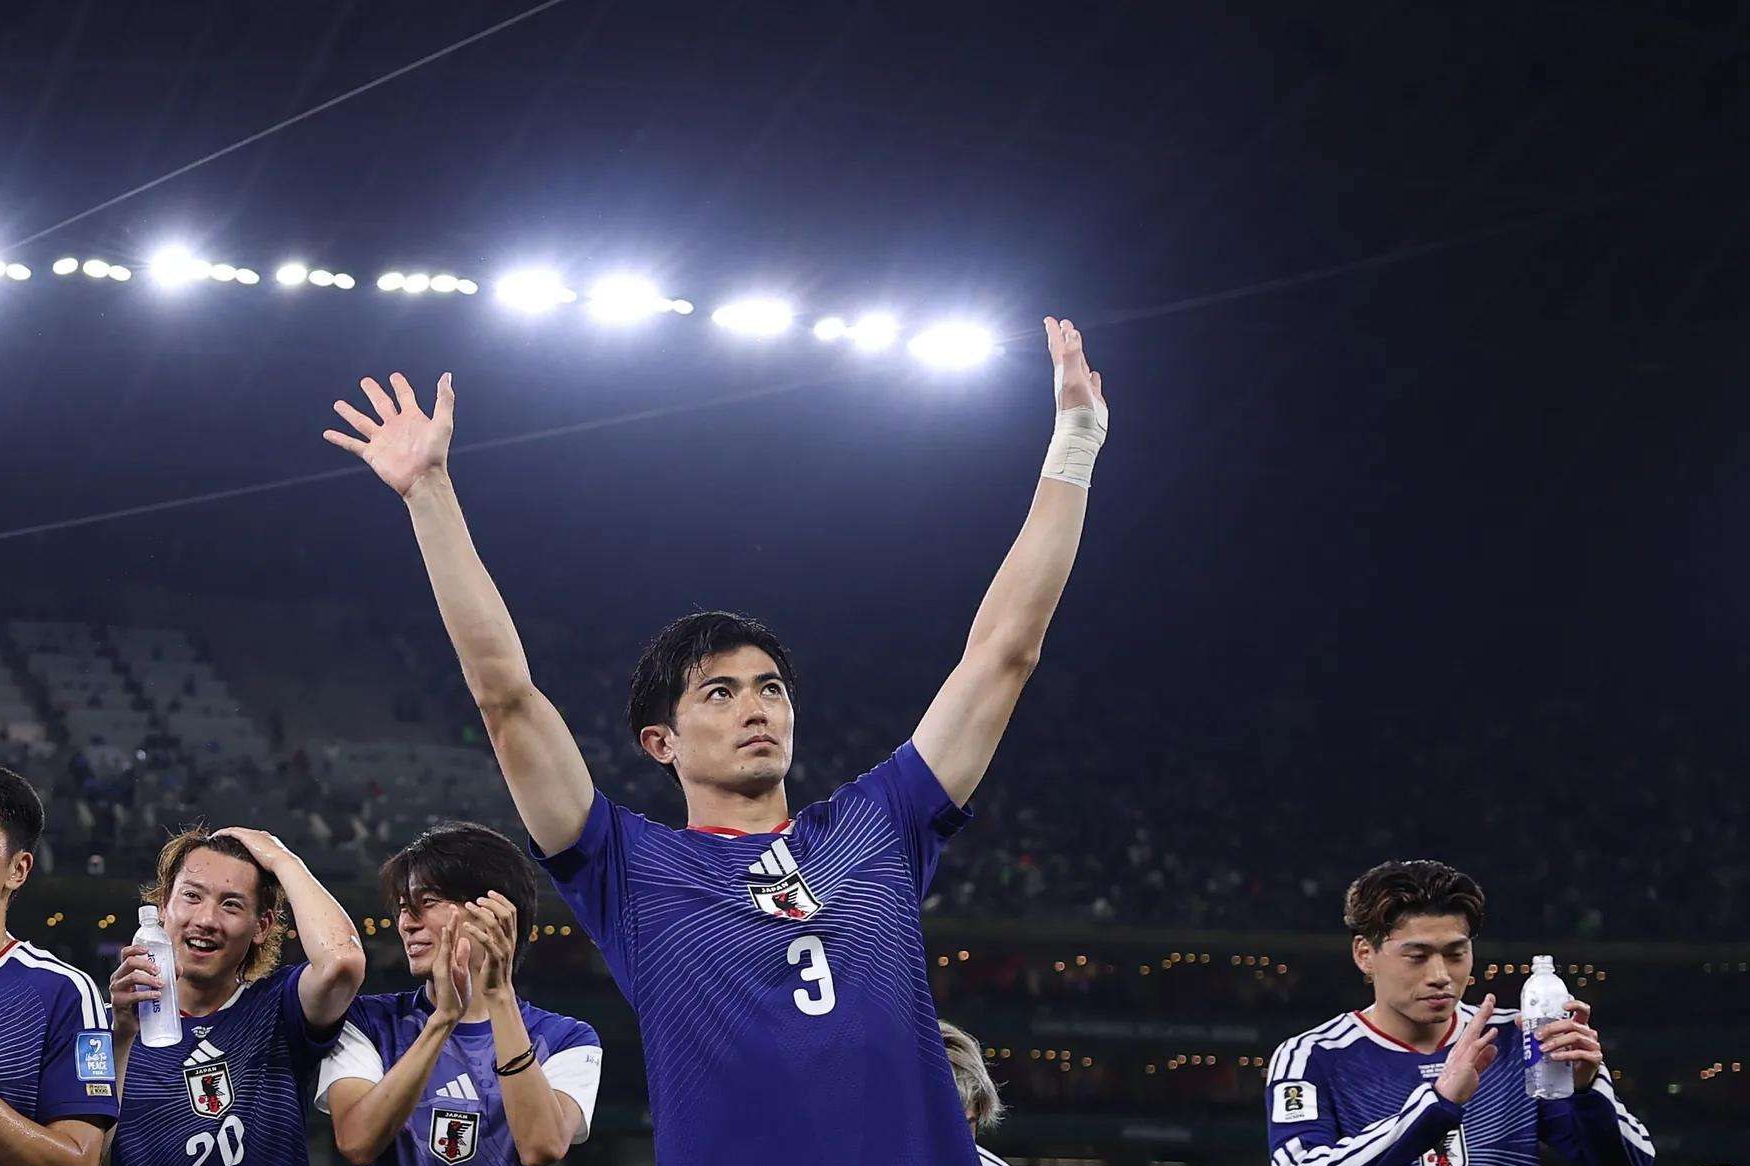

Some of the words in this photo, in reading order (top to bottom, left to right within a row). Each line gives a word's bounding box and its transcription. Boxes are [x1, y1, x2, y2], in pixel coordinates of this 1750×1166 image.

[760, 881, 790, 894] JAPAN
[786, 935, 836, 1016] 3
[195, 1067, 218, 1075] JAPAN
